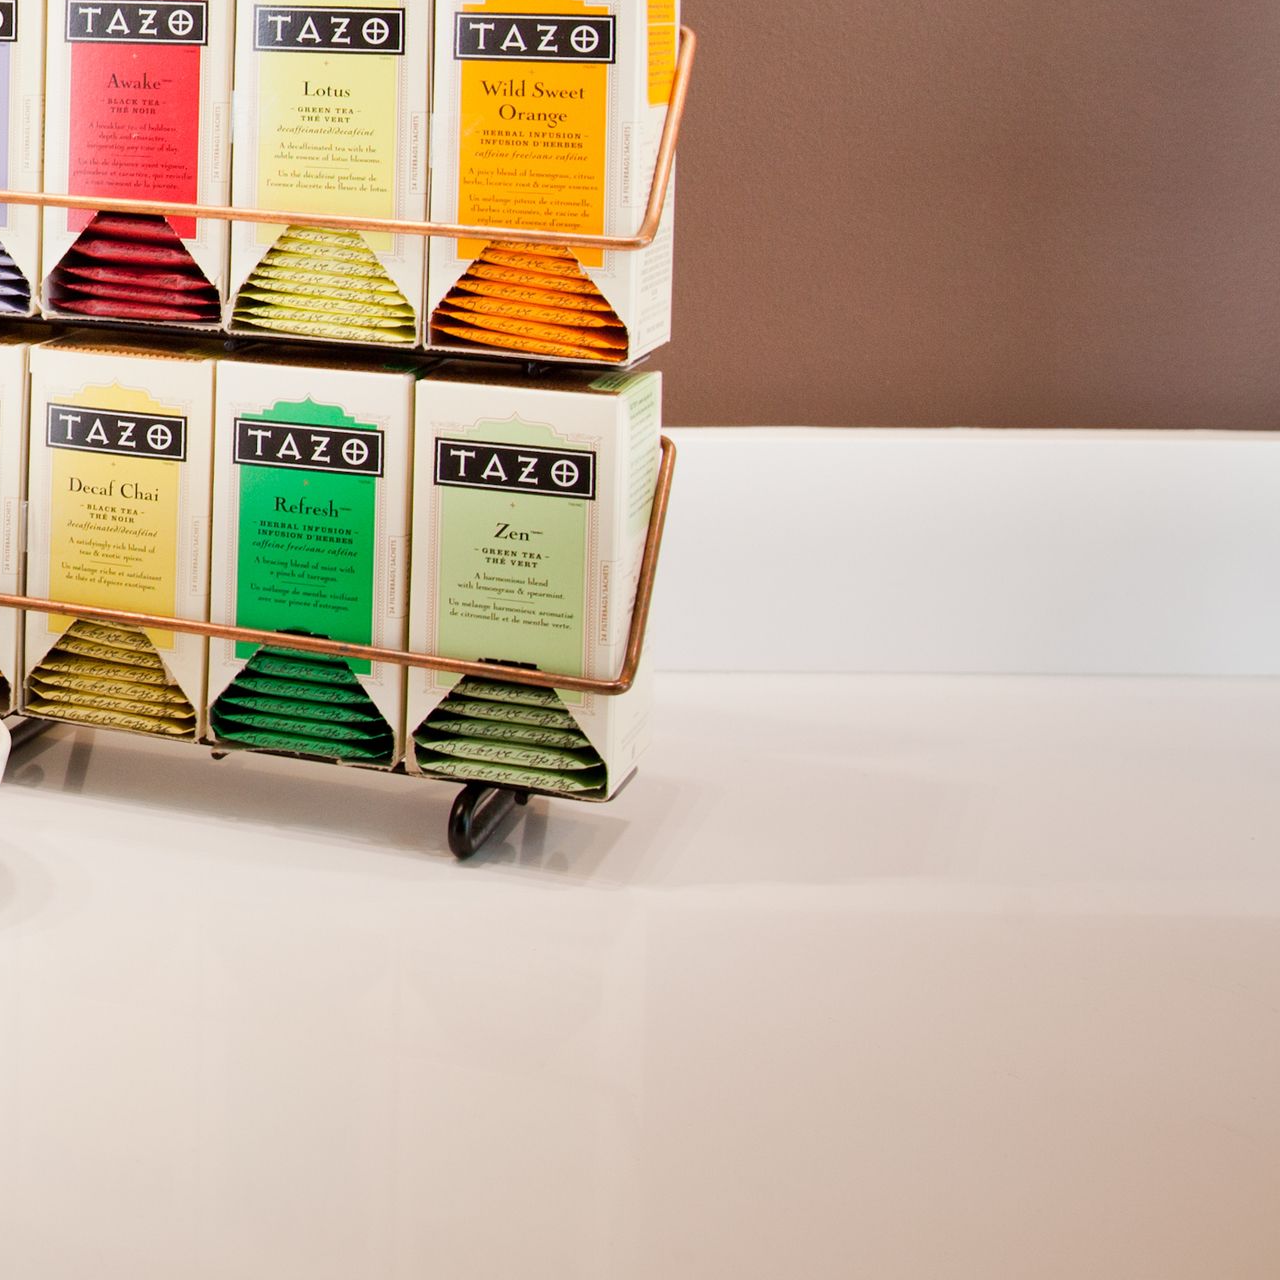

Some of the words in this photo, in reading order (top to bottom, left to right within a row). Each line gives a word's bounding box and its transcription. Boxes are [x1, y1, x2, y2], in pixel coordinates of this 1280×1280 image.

[79, 7, 194, 36] TAZO
[268, 15, 389, 45] TAZO
[470, 23, 599, 53] TAZO
[107, 72, 161, 90] Awake
[303, 81, 351, 98] Lotus
[481, 80, 525, 98] Wild
[532, 82, 585, 100] Sweet
[499, 104, 568, 129] Orange
[483, 129, 525, 137] HERBAL
[529, 131, 582, 139] INFUSION
[480, 138, 529, 146] INFUSION
[532, 140, 583, 148] D'HERBES
[59, 414, 172, 450] TAZO
[248, 428, 369, 465] TAZO
[450, 449, 579, 487] TAZO
[69, 477, 116, 497] Decaf
[120, 482, 159, 502] Chai
[86, 503, 117, 512] BLACK
[120, 507, 138, 515] TEA
[274, 496, 339, 518] Refresh
[111, 515, 135, 523] NOIR
[260, 520, 299, 530] HERBAL
[302, 524, 352, 535] INFUSION
[257, 528, 304, 539] INFUSION
[306, 533, 354, 544] D'HERBES
[494, 522, 530, 541] Zen
[481, 547, 518, 556] GREEN
[521, 551, 542, 559] TEA
[510, 559, 538, 568] VERT
[527, 577, 548, 587] blend
[516, 587, 524, 595] &
[448, 598, 460, 606] Un
[449, 608, 458, 616] de
[511, 615, 520, 623] de
